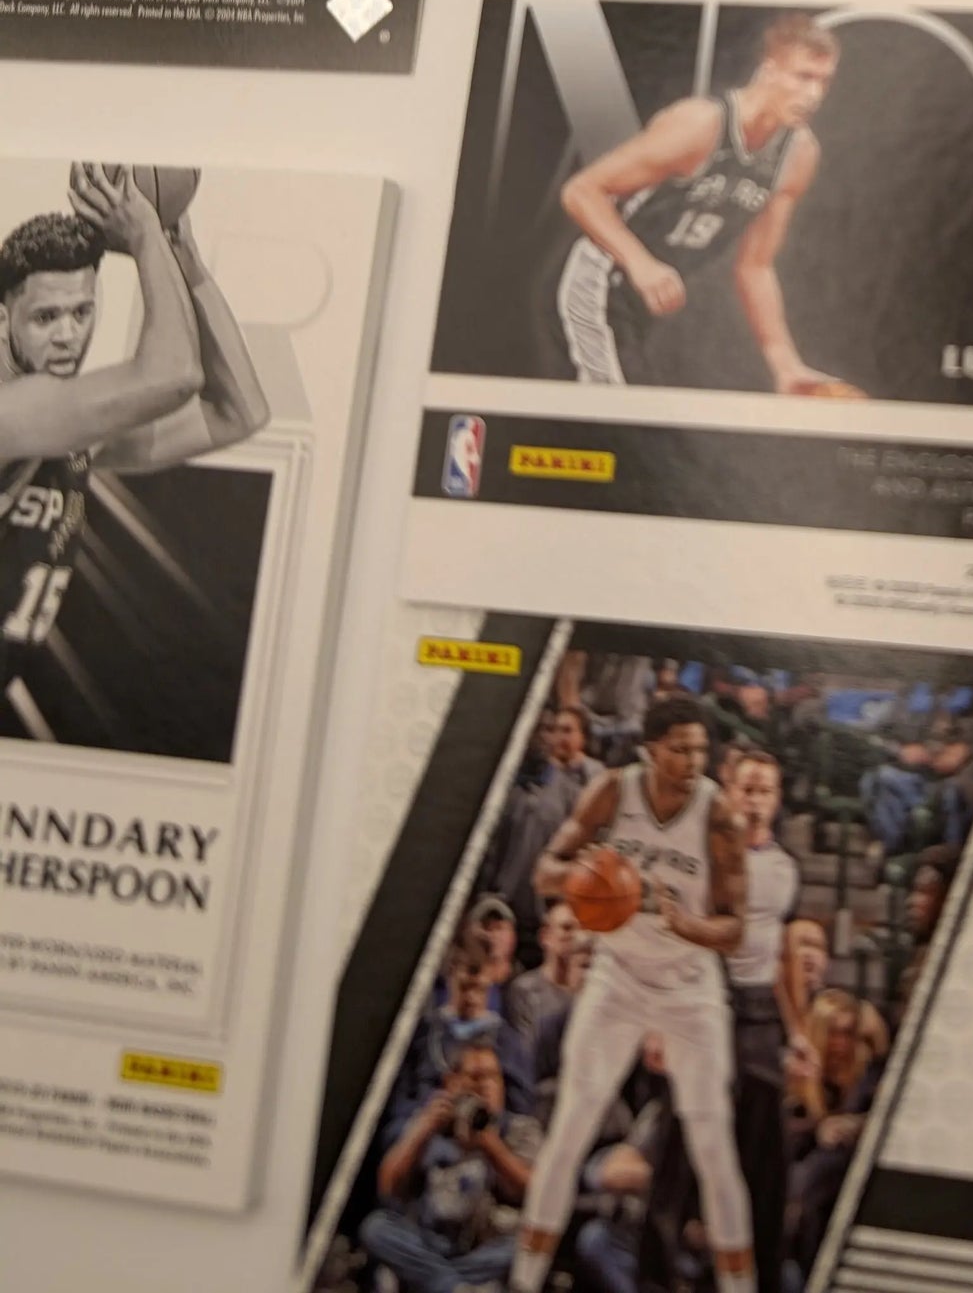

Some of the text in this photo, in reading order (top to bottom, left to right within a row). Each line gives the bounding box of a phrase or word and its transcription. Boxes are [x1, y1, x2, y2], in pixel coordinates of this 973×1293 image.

[516, 449, 610, 477] PANINI
[3, 561, 73, 643] 15
[425, 641, 515, 671] PANINI
[0, 801, 220, 864] NNDARY
